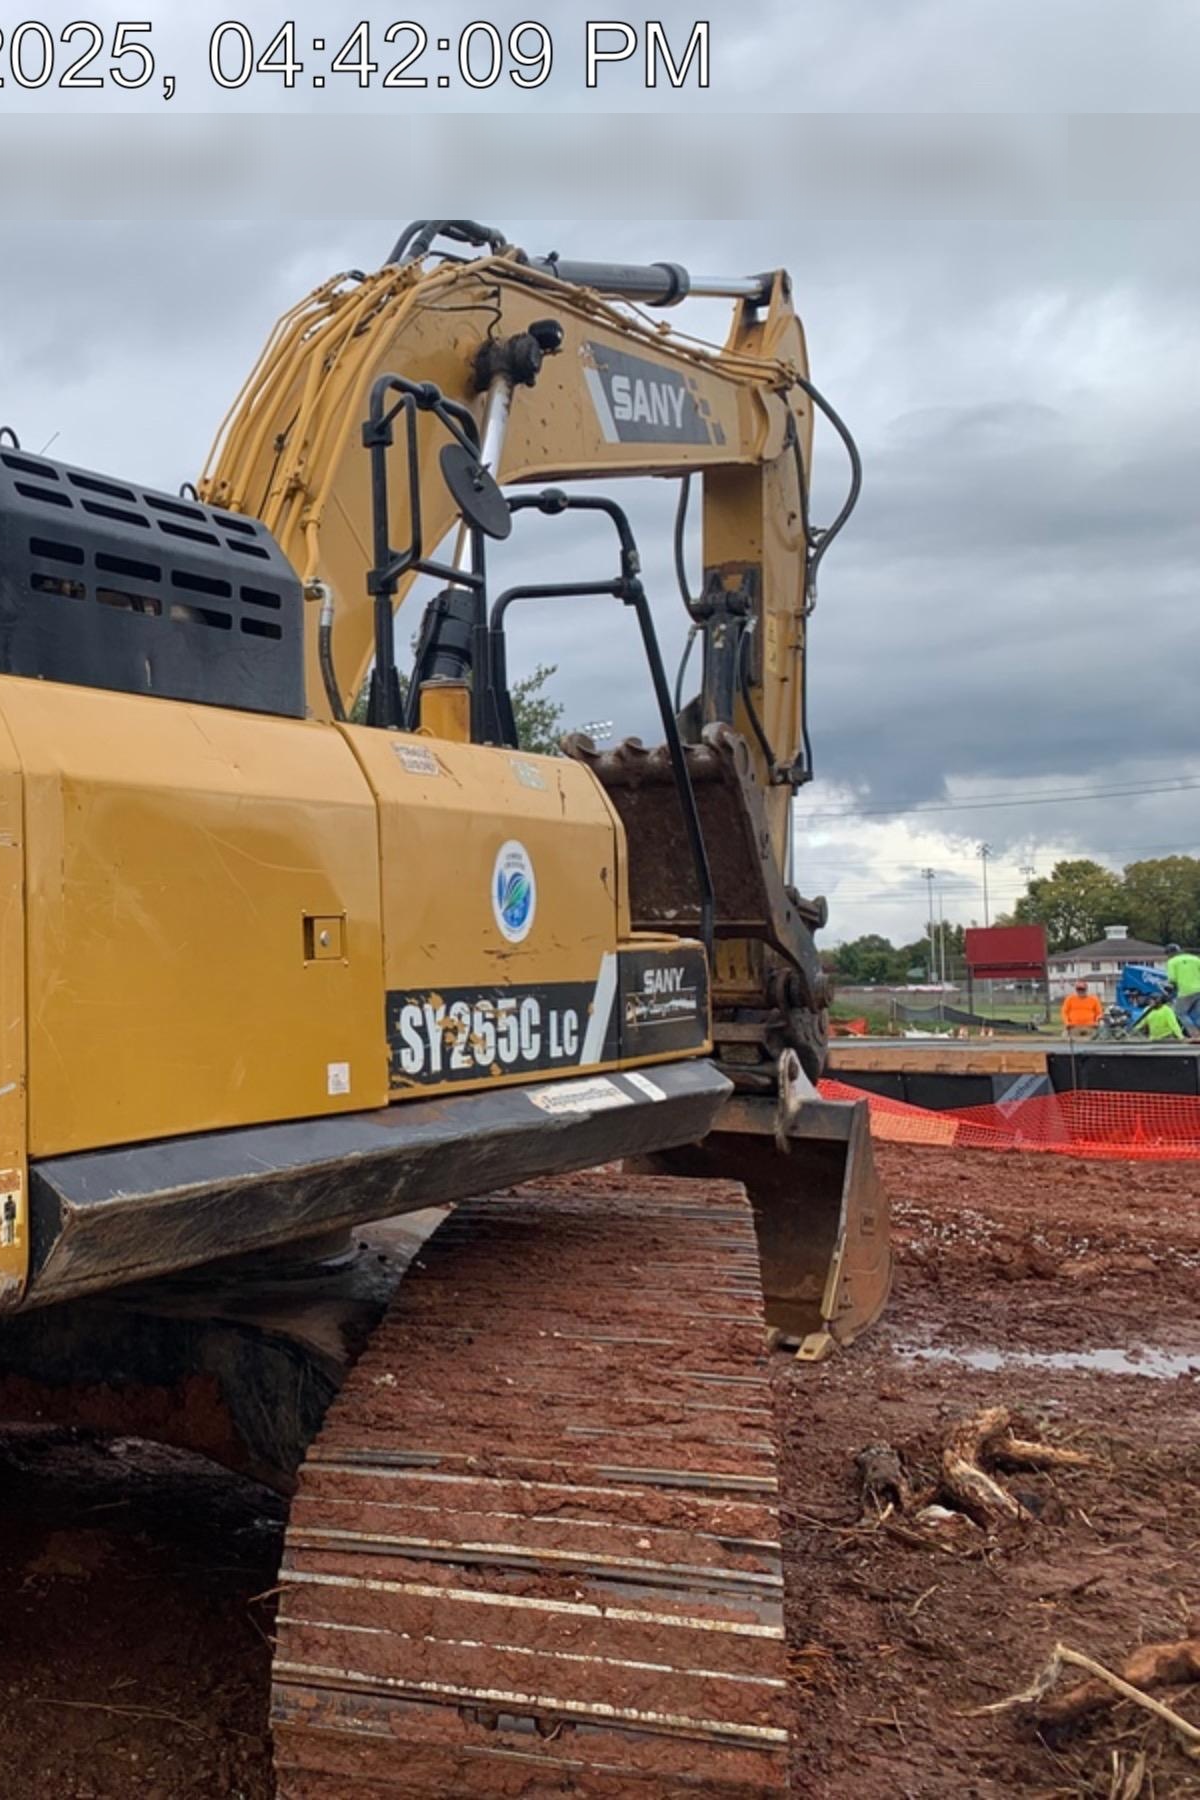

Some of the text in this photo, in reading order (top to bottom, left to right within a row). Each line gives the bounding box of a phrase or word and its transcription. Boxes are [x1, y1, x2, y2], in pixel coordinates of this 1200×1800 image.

[611, 374, 686, 429] SANY
[643, 967, 685, 994] SANY
[549, 1009, 578, 1058] LC
